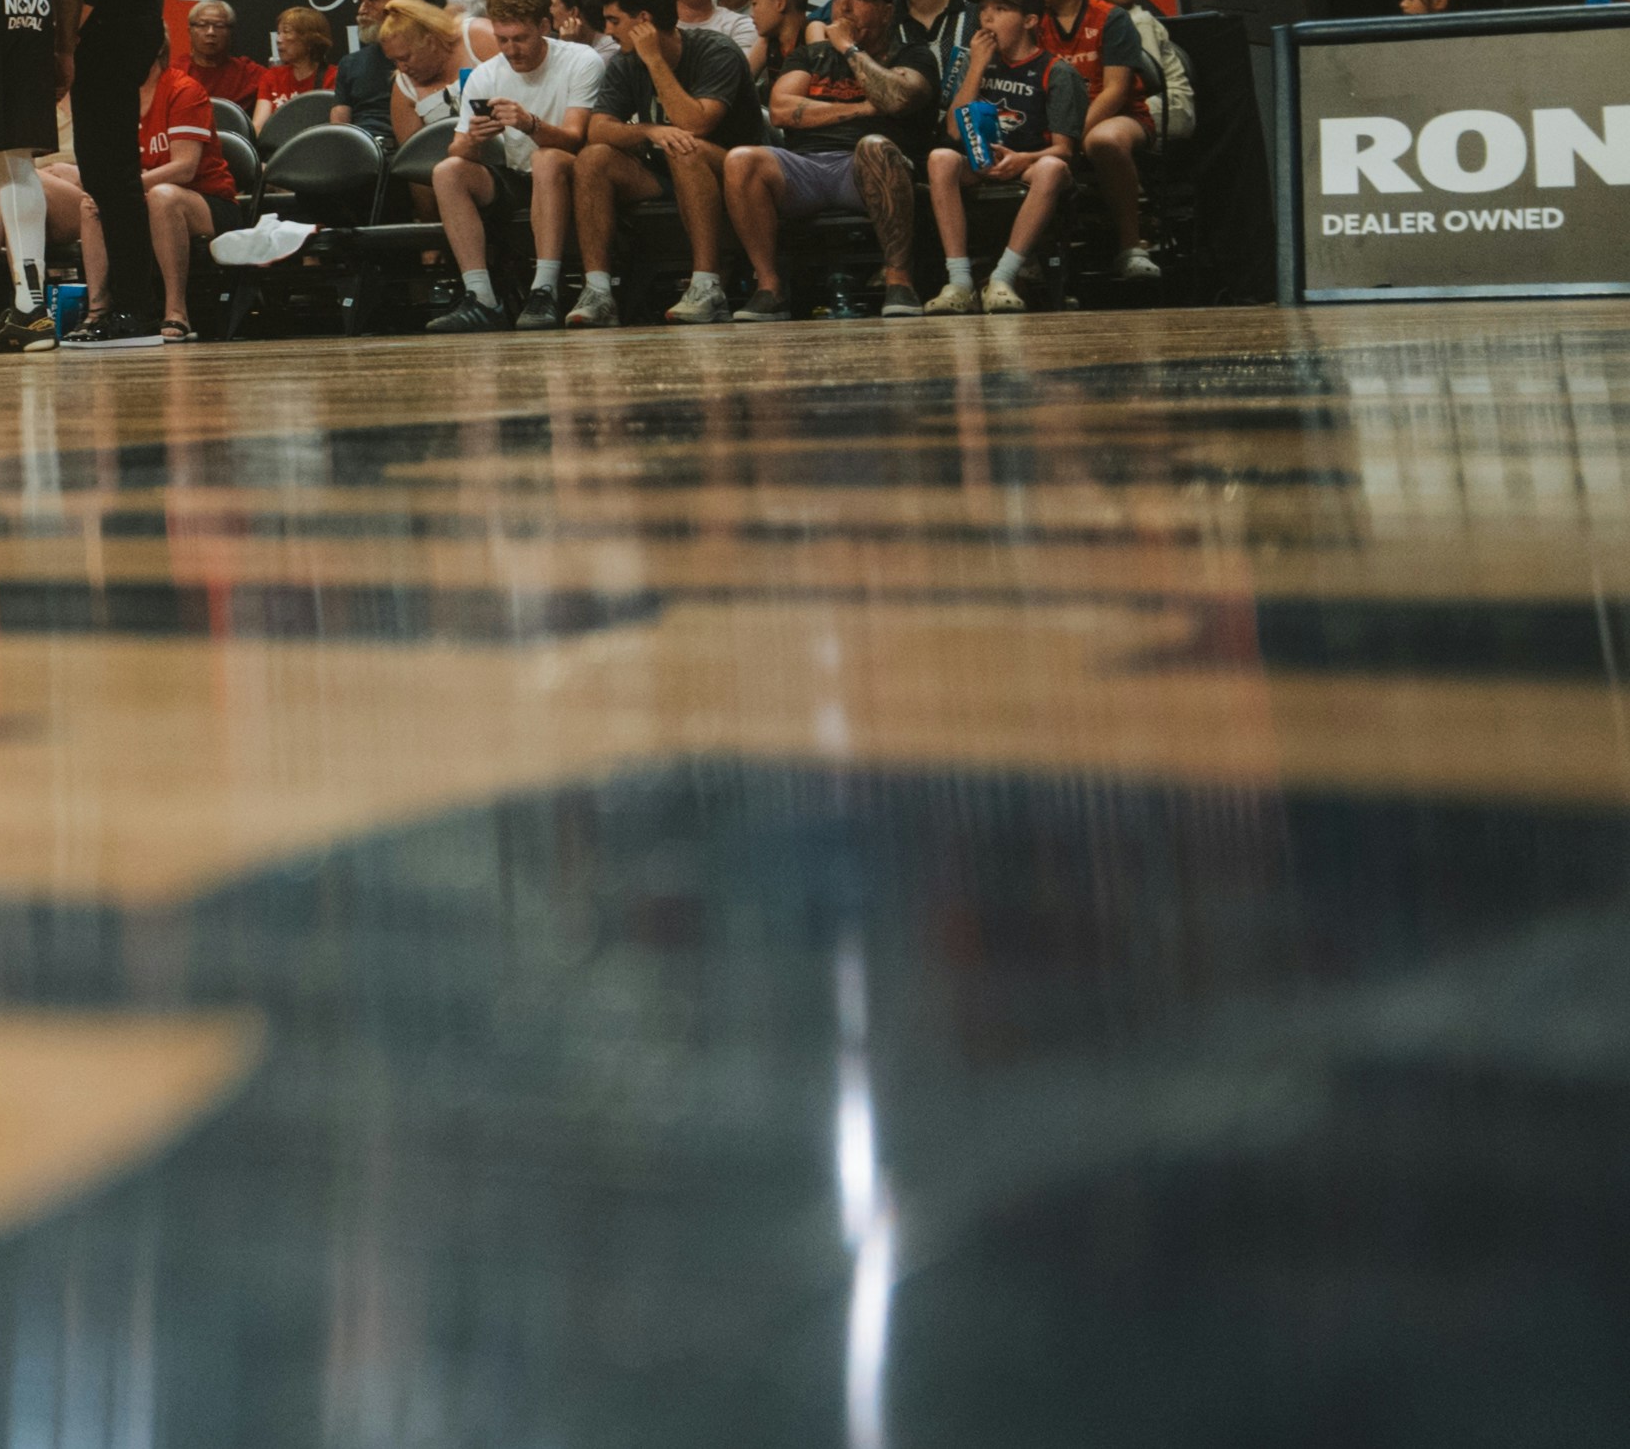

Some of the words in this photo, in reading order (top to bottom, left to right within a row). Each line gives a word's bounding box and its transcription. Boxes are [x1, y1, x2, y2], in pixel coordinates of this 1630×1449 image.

[8, 16, 43, 32] DENTAL
[1322, 212, 1437, 236] DEALER
[1443, 207, 1565, 232] OWNED
